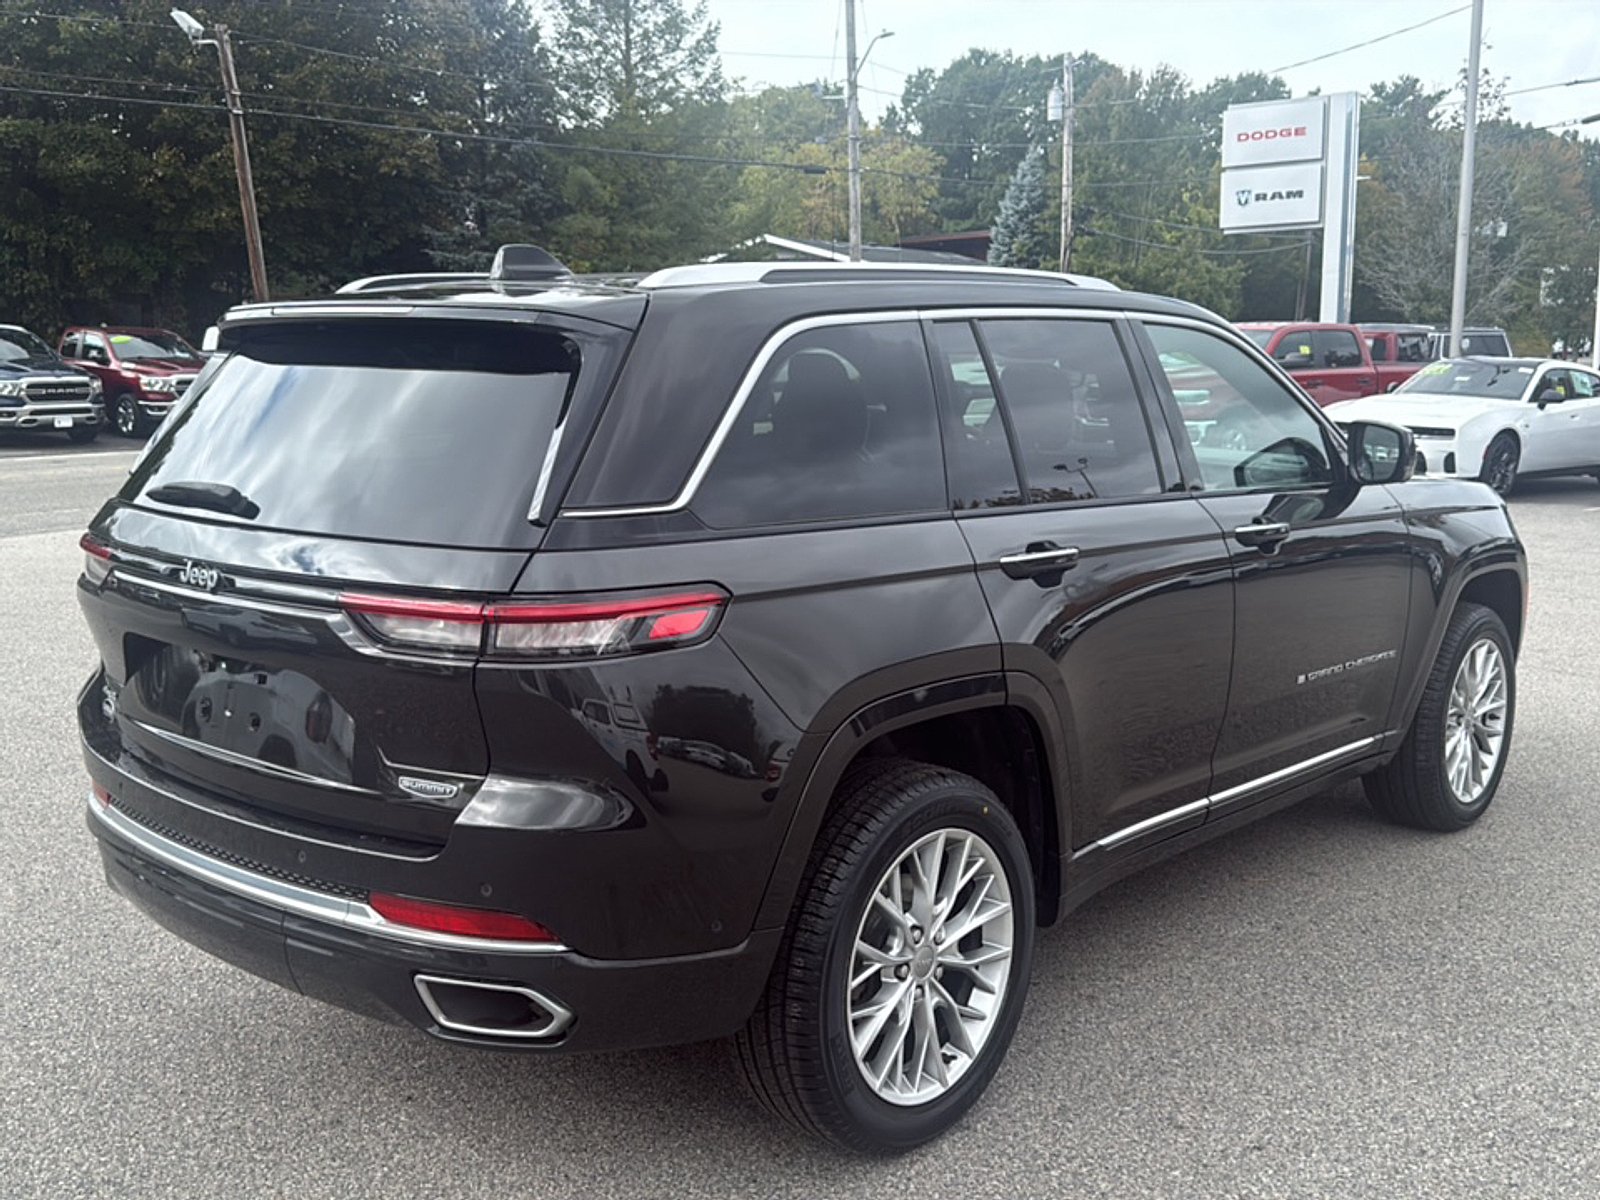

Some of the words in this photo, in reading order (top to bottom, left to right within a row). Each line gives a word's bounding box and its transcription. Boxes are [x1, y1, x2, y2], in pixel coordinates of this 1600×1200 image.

[1236, 126, 1307, 143] DODGE
[1254, 189, 1305, 202] RAM
[179, 558, 218, 590] Jeep
